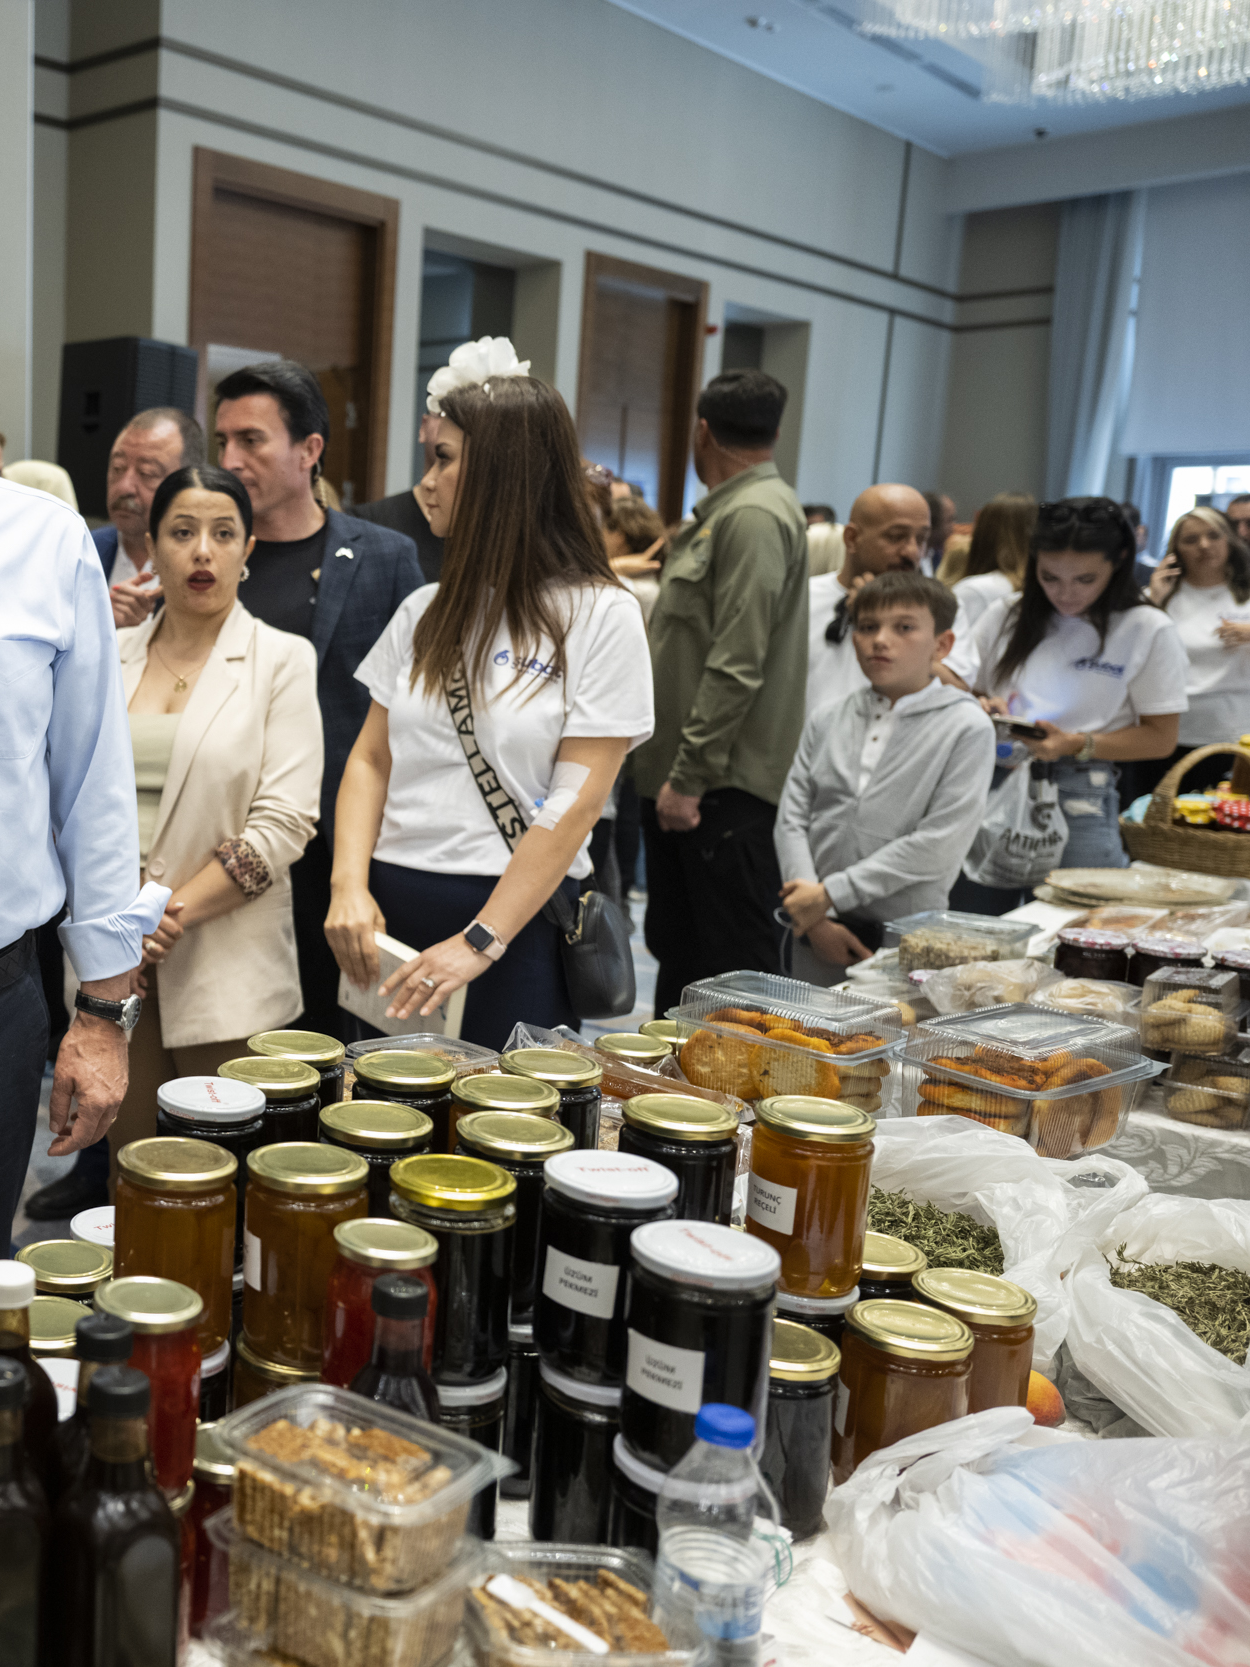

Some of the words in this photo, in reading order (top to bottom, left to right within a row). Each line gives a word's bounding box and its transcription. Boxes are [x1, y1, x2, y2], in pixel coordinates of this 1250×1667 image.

[576, 1165, 650, 1174] Twist-off
[753, 1184, 782, 1206] TURUNÇ
[753, 1197, 777, 1215] REÇELİ
[563, 1265, 593, 1284] ÜZÜM
[644, 1354, 676, 1375] ÜZÜM
